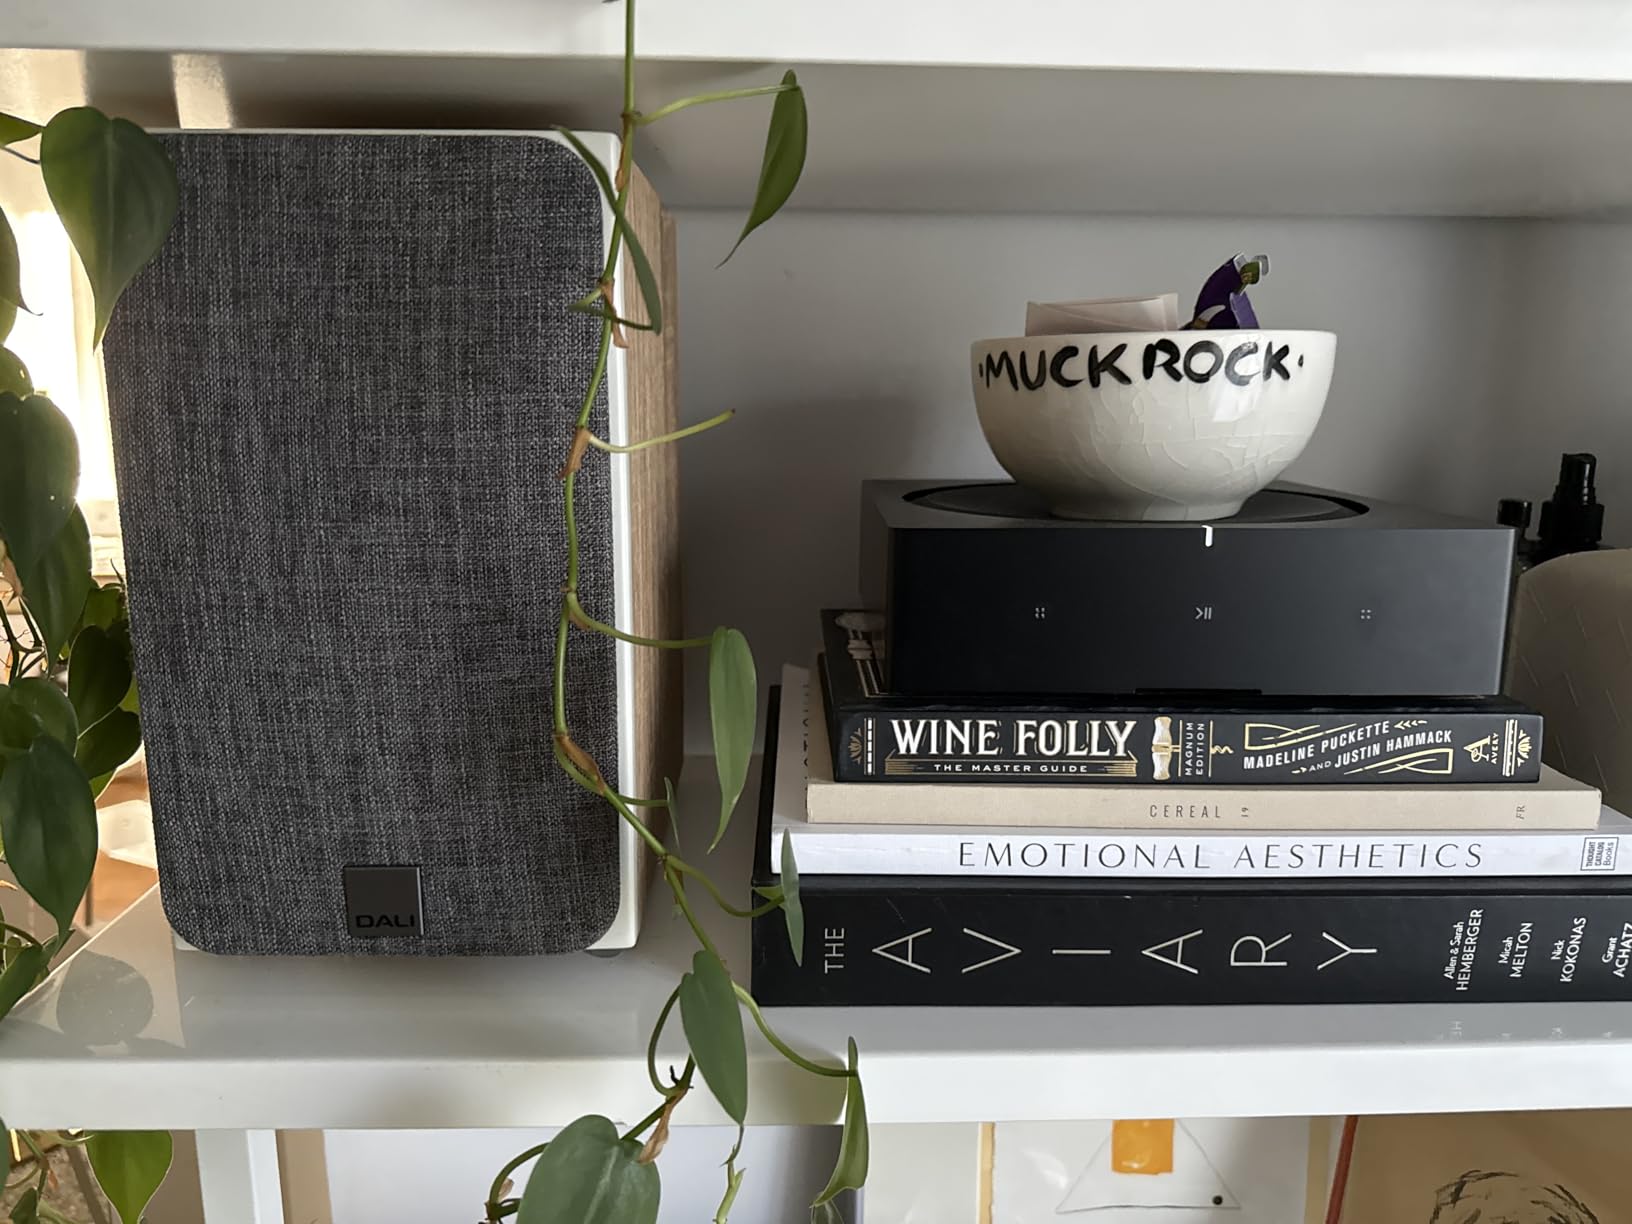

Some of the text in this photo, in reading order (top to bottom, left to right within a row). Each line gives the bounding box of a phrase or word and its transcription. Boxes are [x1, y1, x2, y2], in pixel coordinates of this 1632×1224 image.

[985, 338, 1290, 391] MUCK ROCK
[890, 719, 1137, 757] WINE FOLLY
[1185, 722, 1194, 776] MAGNUM
[1195, 723, 1205, 775] EDITION
[1243, 720, 1391, 769] MADELINE PUCKETTE
[1308, 730, 1452, 772] AND JUSTIN HAMMACK
[1490, 732, 1499, 765] AVERY
[934, 764, 1088, 773] THE MASTER GUIDE
[1149, 804, 1221, 818] CEREAL
[958, 842, 1483, 869] EMOTIONAL AESTHETICS
[355, 914, 415, 928] DALI
[824, 927, 1378, 975] THE AVIARY
[1443, 921, 1465, 980] Allen & Sarah
[1456, 908, 1484, 991] HEMBERGER
[1498, 936, 1513, 964] Micah
[1509, 922, 1534, 978] MELTON
[1551, 940, 1565, 960] Nick
[1560, 917, 1587, 982] KOKONAS
[1601, 937, 1618, 963] Grant
